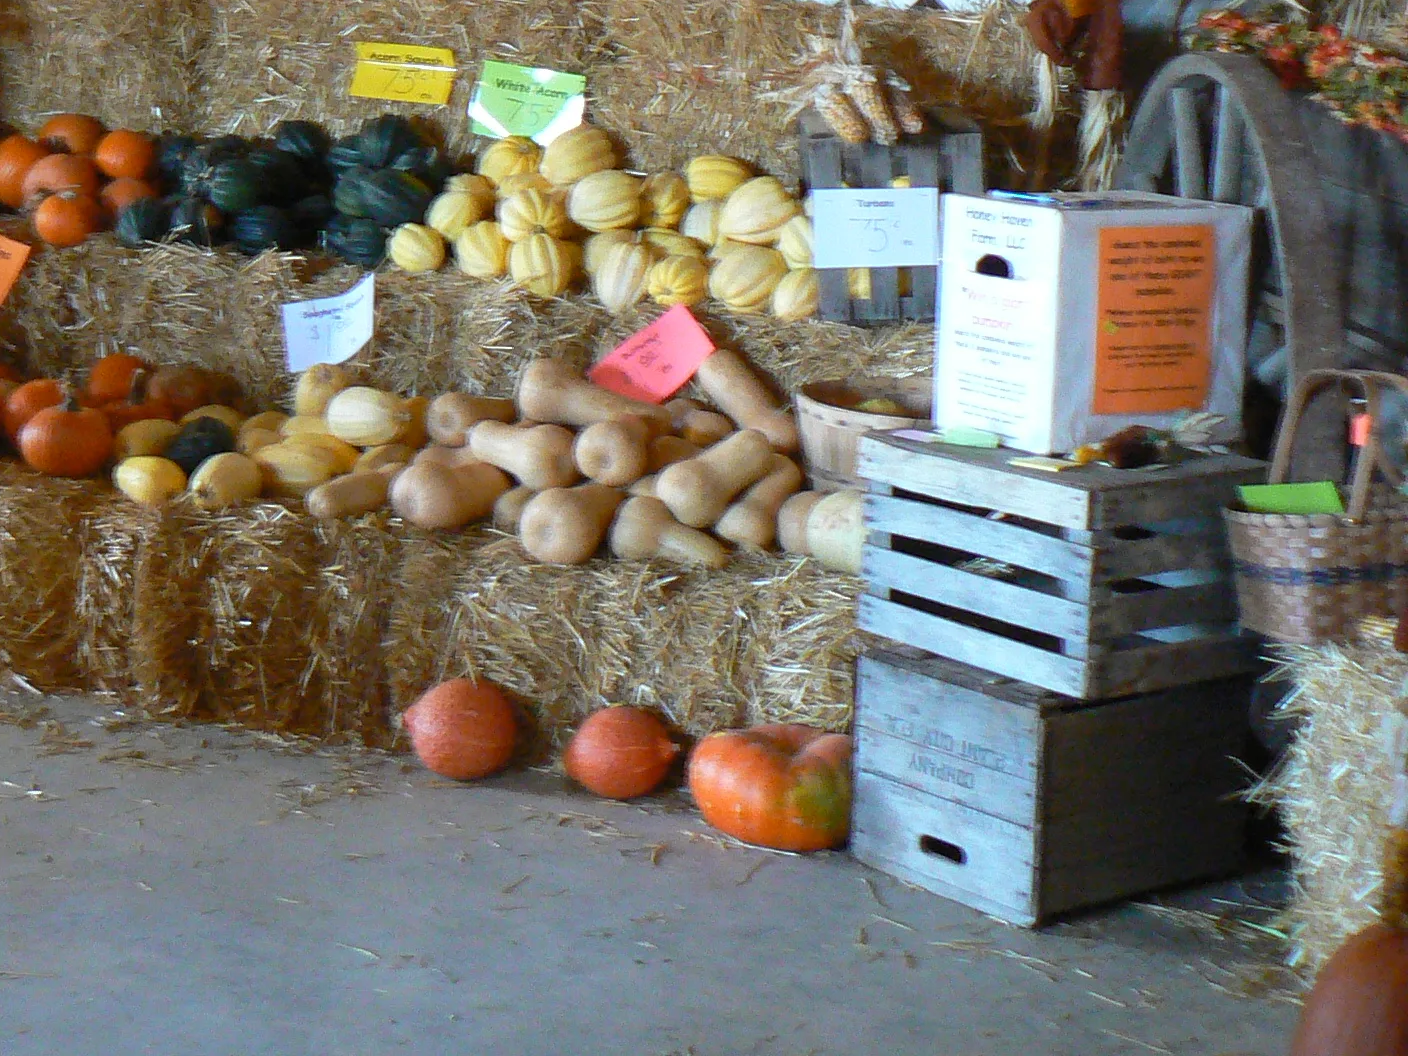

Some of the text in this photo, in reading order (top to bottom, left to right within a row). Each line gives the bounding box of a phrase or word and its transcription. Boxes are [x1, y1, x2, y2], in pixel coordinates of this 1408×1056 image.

[370, 52, 401, 61] Acorn
[496, 78, 568, 99] White Acorn
